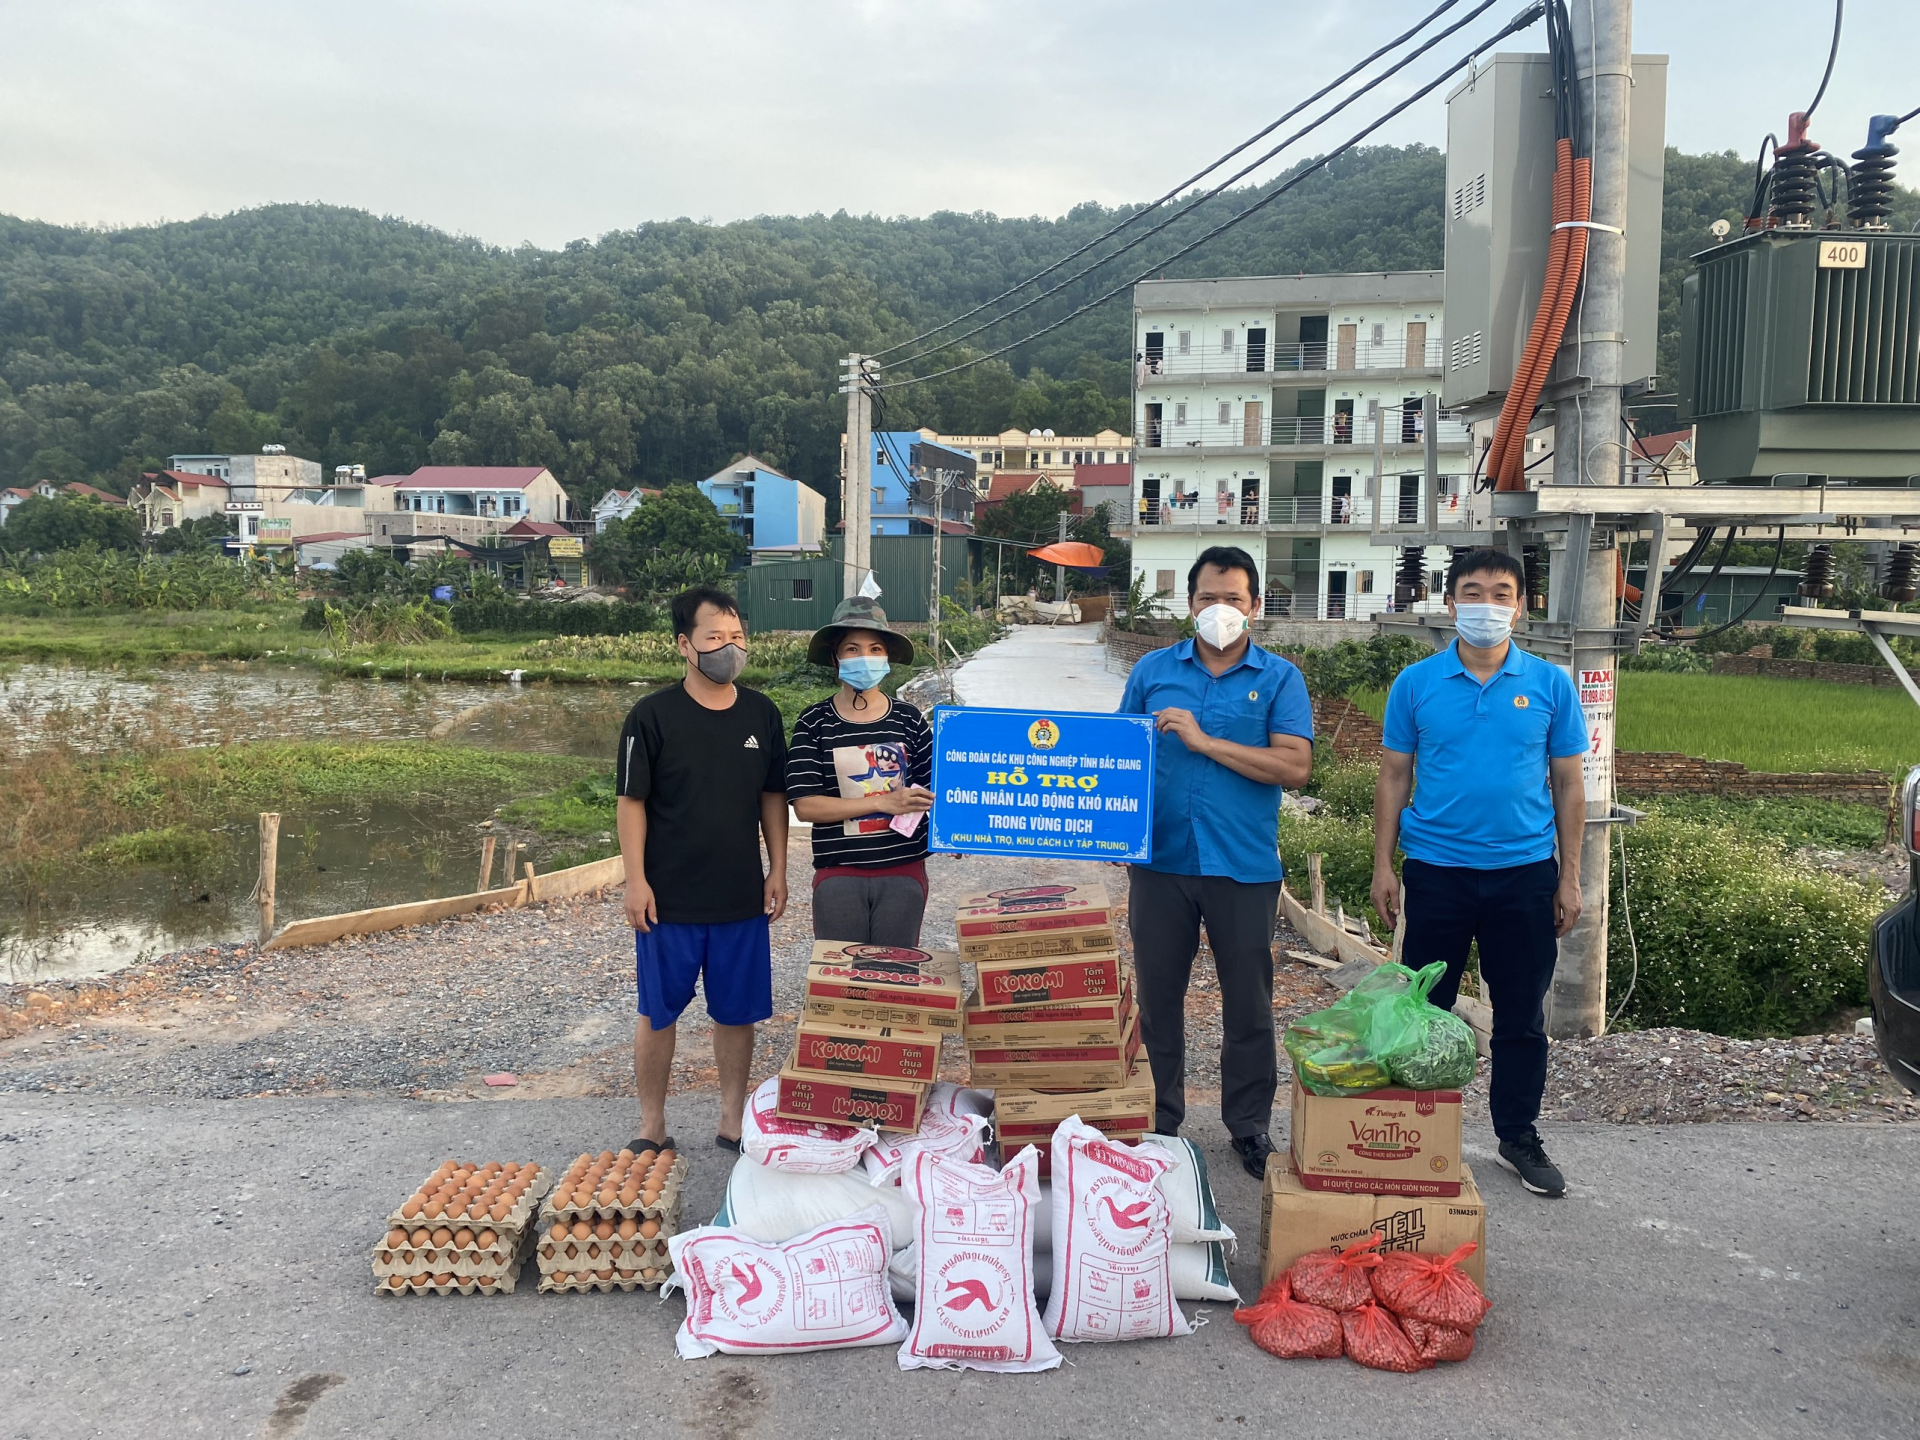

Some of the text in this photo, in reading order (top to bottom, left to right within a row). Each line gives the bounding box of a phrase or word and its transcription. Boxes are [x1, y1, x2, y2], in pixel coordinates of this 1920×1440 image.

[1828, 247, 1858, 262] 400
[1582, 671, 1613, 683] TAXI
[946, 751, 1141, 771] CÔNG ĐOÀN CÁC KHU CÔNG NGHIỆP TỈNH BẮC GIANG
[986, 766, 1099, 793] HỖ TRỢ
[946, 787, 1138, 813] CÔNG NHÂN LAO ĐỘNG KHÓ KHĂN
[988, 815, 1093, 836] TRONG VÙNG DỊCH
[951, 833, 1129, 852] (KHU NHÀ TRỌ, KHU CÁCH LY TẬP TRUNG)
[969, 900, 1090, 916] KOKOMI
[991, 921, 1027, 933] KOKOMI
[818, 966, 945, 986] KOKOMI
[1083, 967, 1104, 976] Tôm
[994, 971, 1064, 994] KOKOMI
[1083, 978, 1106, 986] chua
[840, 986, 878, 1000] KOKOMI
[1087, 987, 1104, 995] cay
[998, 1011, 1034, 1021] KOKOMI
[811, 1041, 881, 1063] KOKOMI
[902, 1049, 922, 1058] Tôm
[1004, 1051, 1040, 1061] KOKOMI
[899, 1059, 922, 1068] chua
[902, 1068, 918, 1077] cay
[795, 1082, 812, 1091] cay
[792, 1091, 815, 1100] chua
[792, 1101, 812, 1111] Tôm
[832, 1097, 903, 1121] KOKOMI
[1322, 1179, 1440, 1193] BÍ QUYẾT CHO CÁC MÓN GIÒN NGON
[1449, 1208, 1478, 1216] 03NM259
[1330, 1208, 1426, 1243] NƯỚC CHẤM SIÊU
